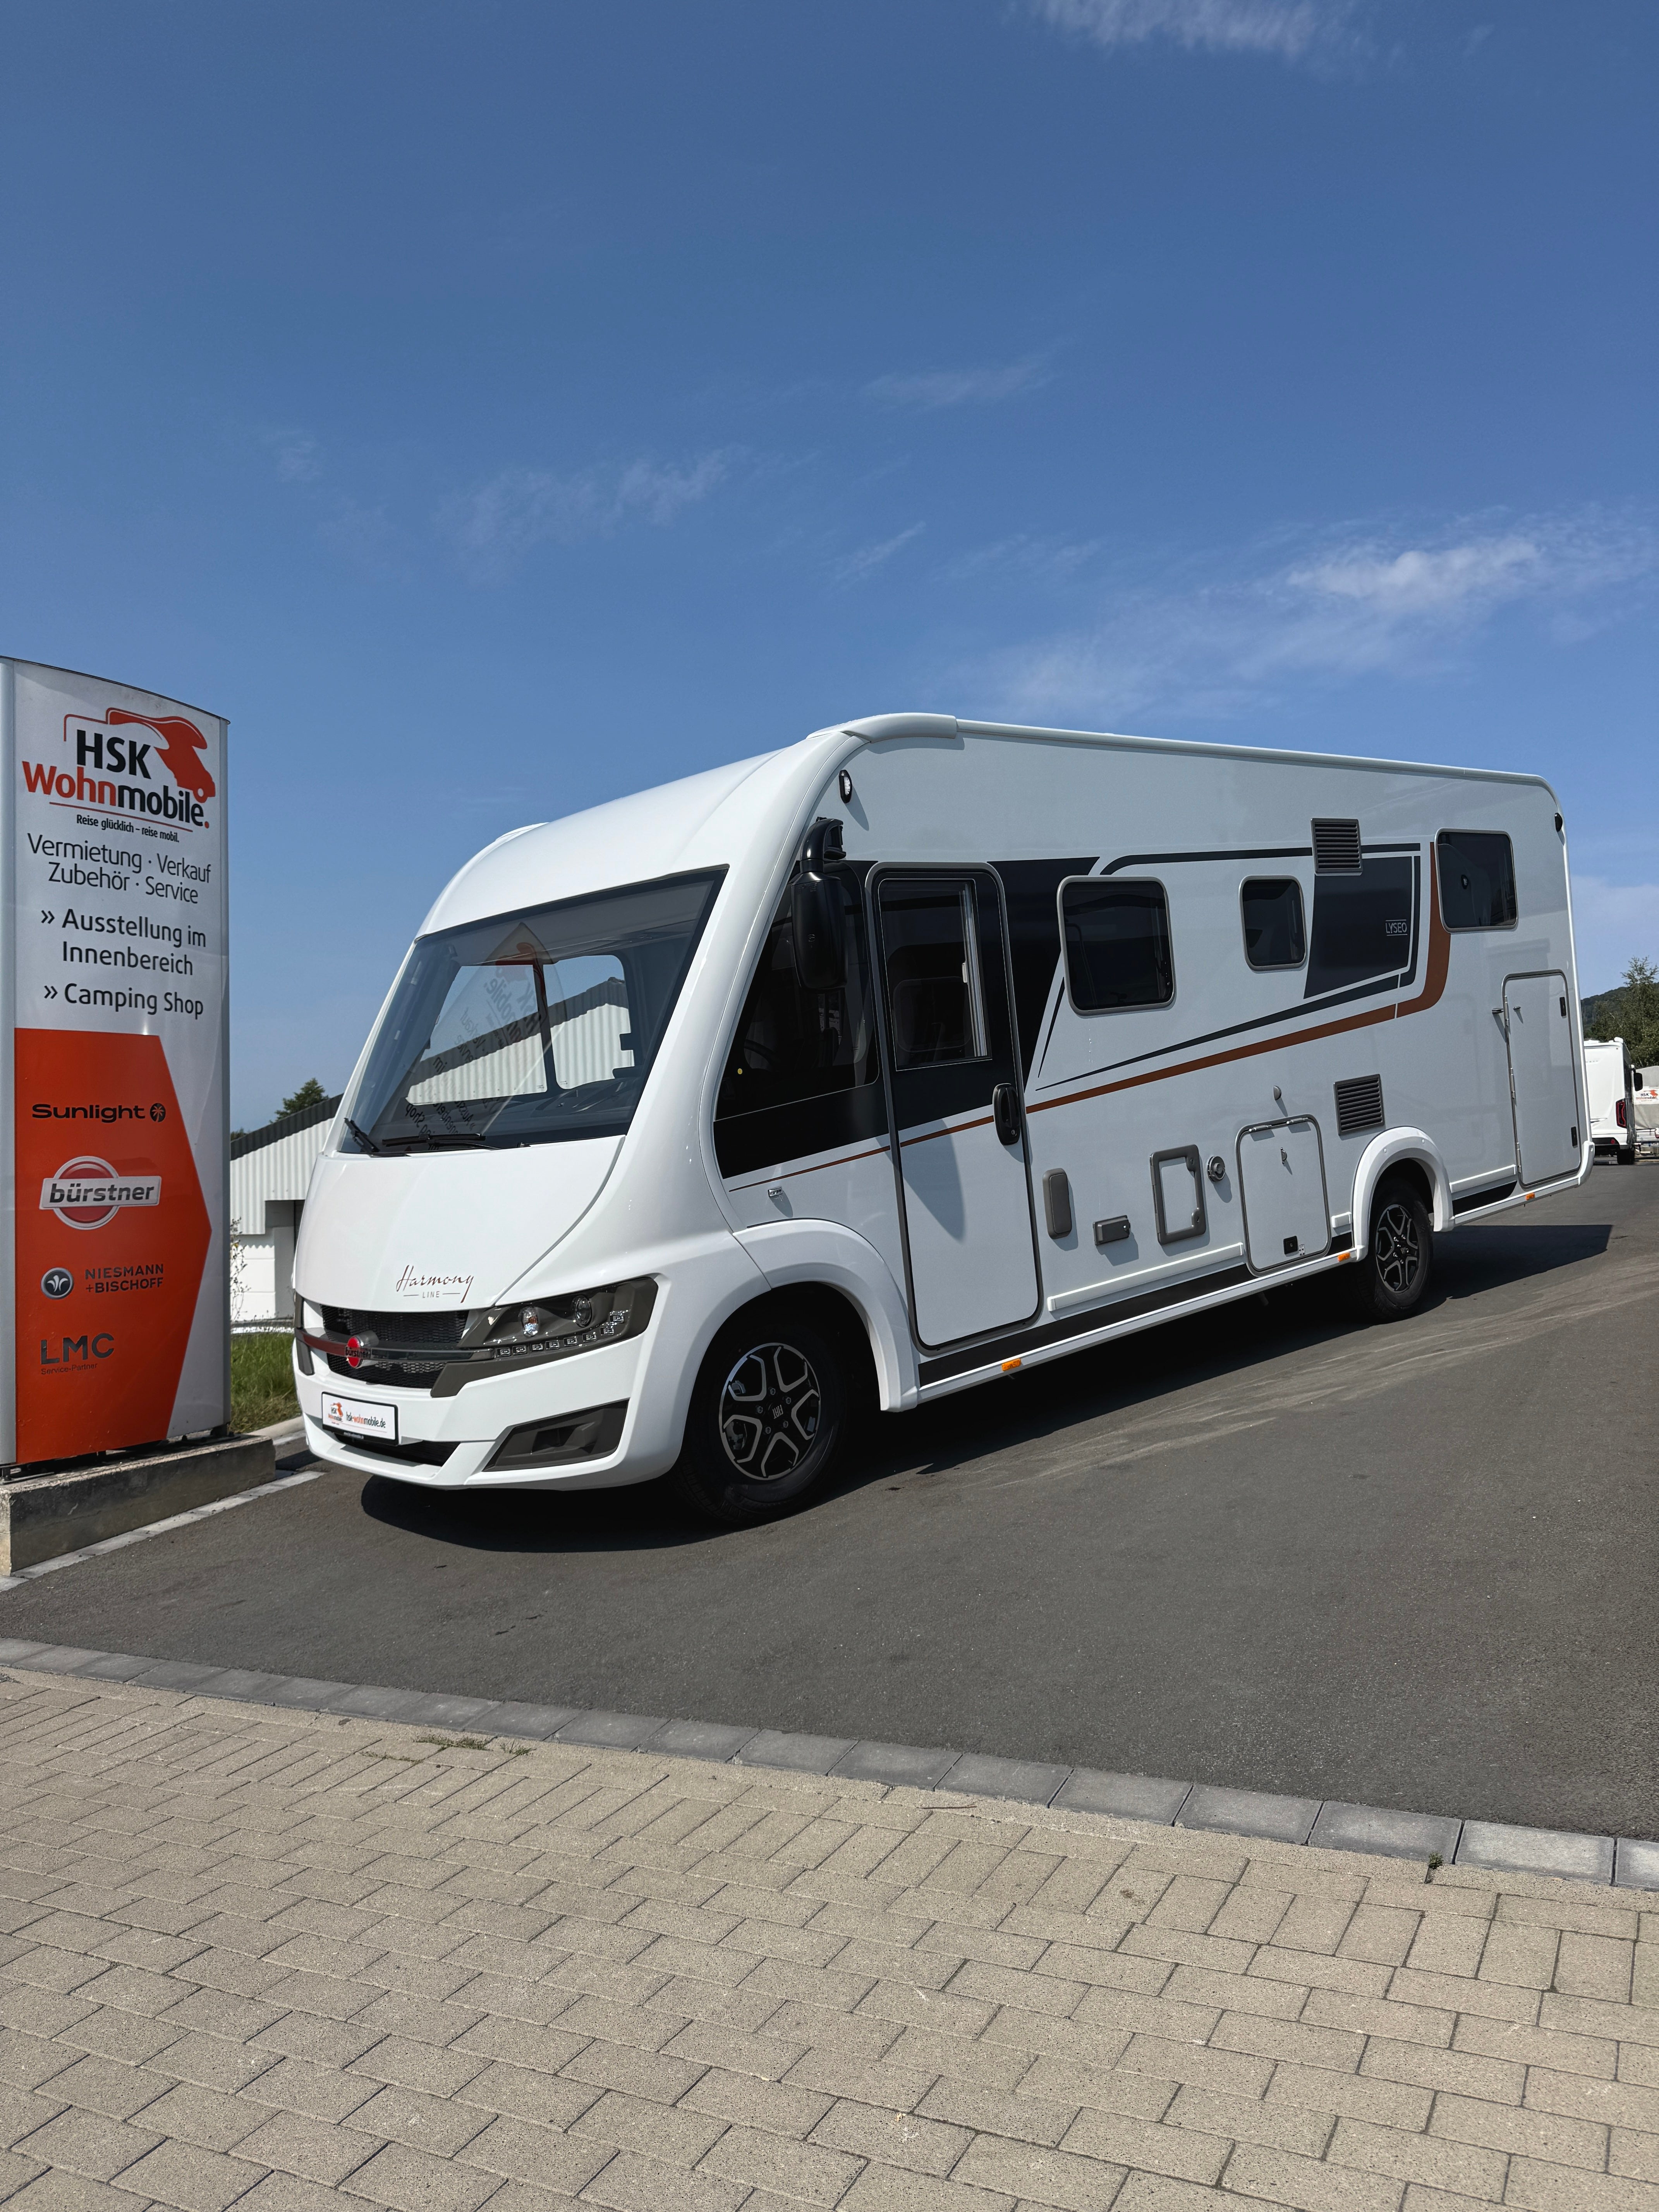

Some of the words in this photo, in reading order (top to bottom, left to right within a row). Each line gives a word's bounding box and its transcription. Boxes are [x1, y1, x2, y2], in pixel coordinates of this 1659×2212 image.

[77, 730, 151, 779] HSK
[22, 761, 210, 828] Wohnmobile.
[77, 814, 98, 826] Reise
[101, 817, 134, 833] glücklich
[142, 826, 158, 838] reise
[160, 830, 179, 843] mobil.
[27, 833, 142, 873] Vermietung
[157, 853, 211, 883] Verkauf
[48, 862, 130, 891] Zubehör
[145, 876, 198, 903] Service
[62, 908, 182, 948] Ausstellung
[188, 925, 206, 947] im
[1385, 922, 1407, 934] LYSEO
[63, 941, 192, 975] Innenbereich
[65, 983, 157, 1015] Camping
[164, 992, 203, 1020] Shop
[32, 1104, 146, 1123] Sunlight
[50, 1183, 155, 1203] bürstner
[85, 1264, 164, 1279] NIESMANN
[396, 1265, 474, 1303] Harmony
[41, 1333, 114, 1365] LMC
[41, 1363, 98, 1375] Service-Partner
[346, 1411, 386, 1428] hsk-wohnmobile.de
[773, 1404, 783, 1419] FIAT
